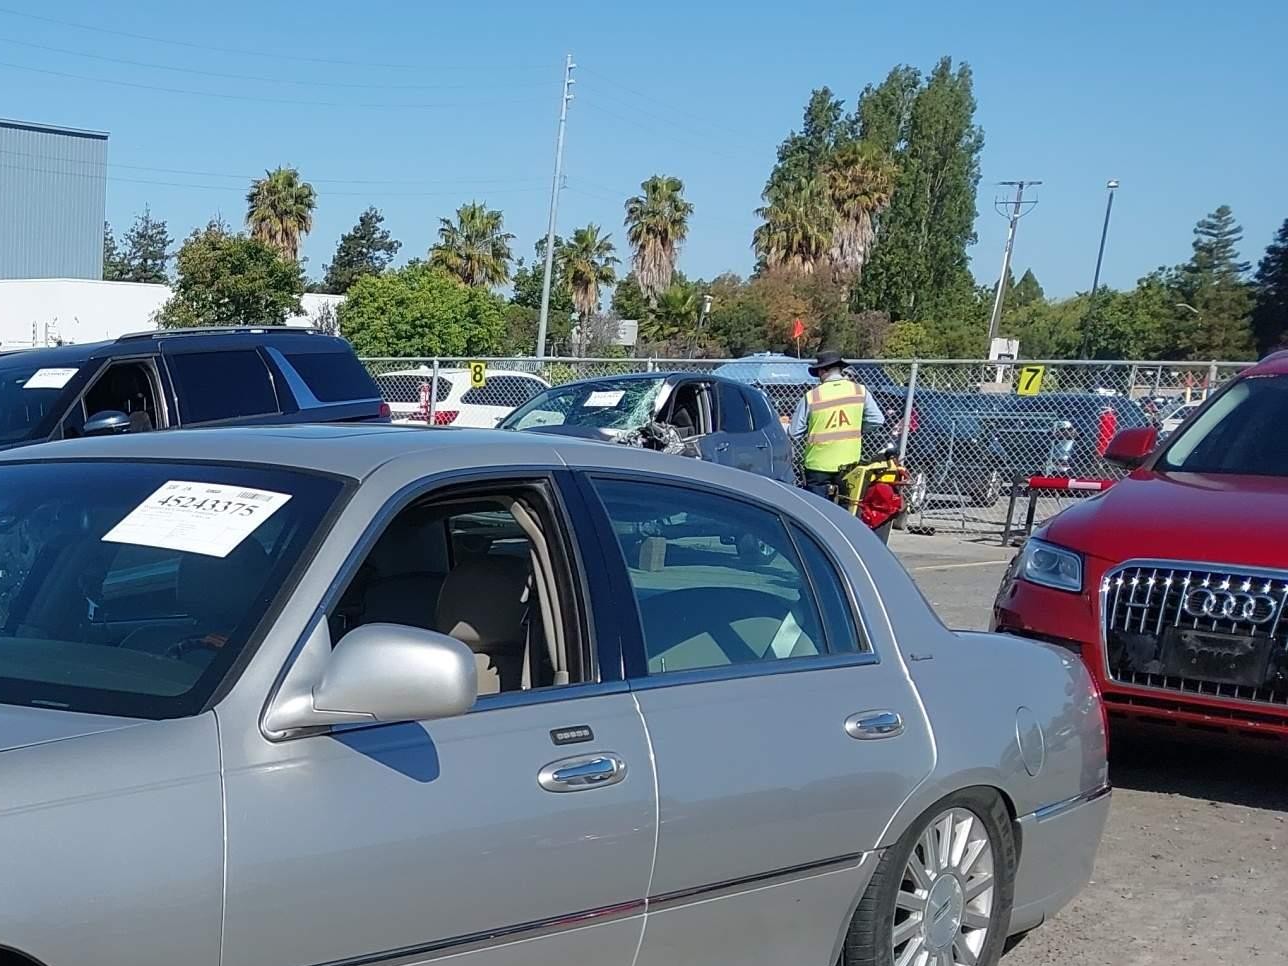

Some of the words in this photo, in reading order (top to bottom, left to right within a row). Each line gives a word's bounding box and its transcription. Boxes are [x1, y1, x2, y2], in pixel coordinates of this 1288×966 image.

[472, 364, 483, 383] 8
[1024, 367, 1040, 391] 7
[158, 495, 260, 516] 45243375
